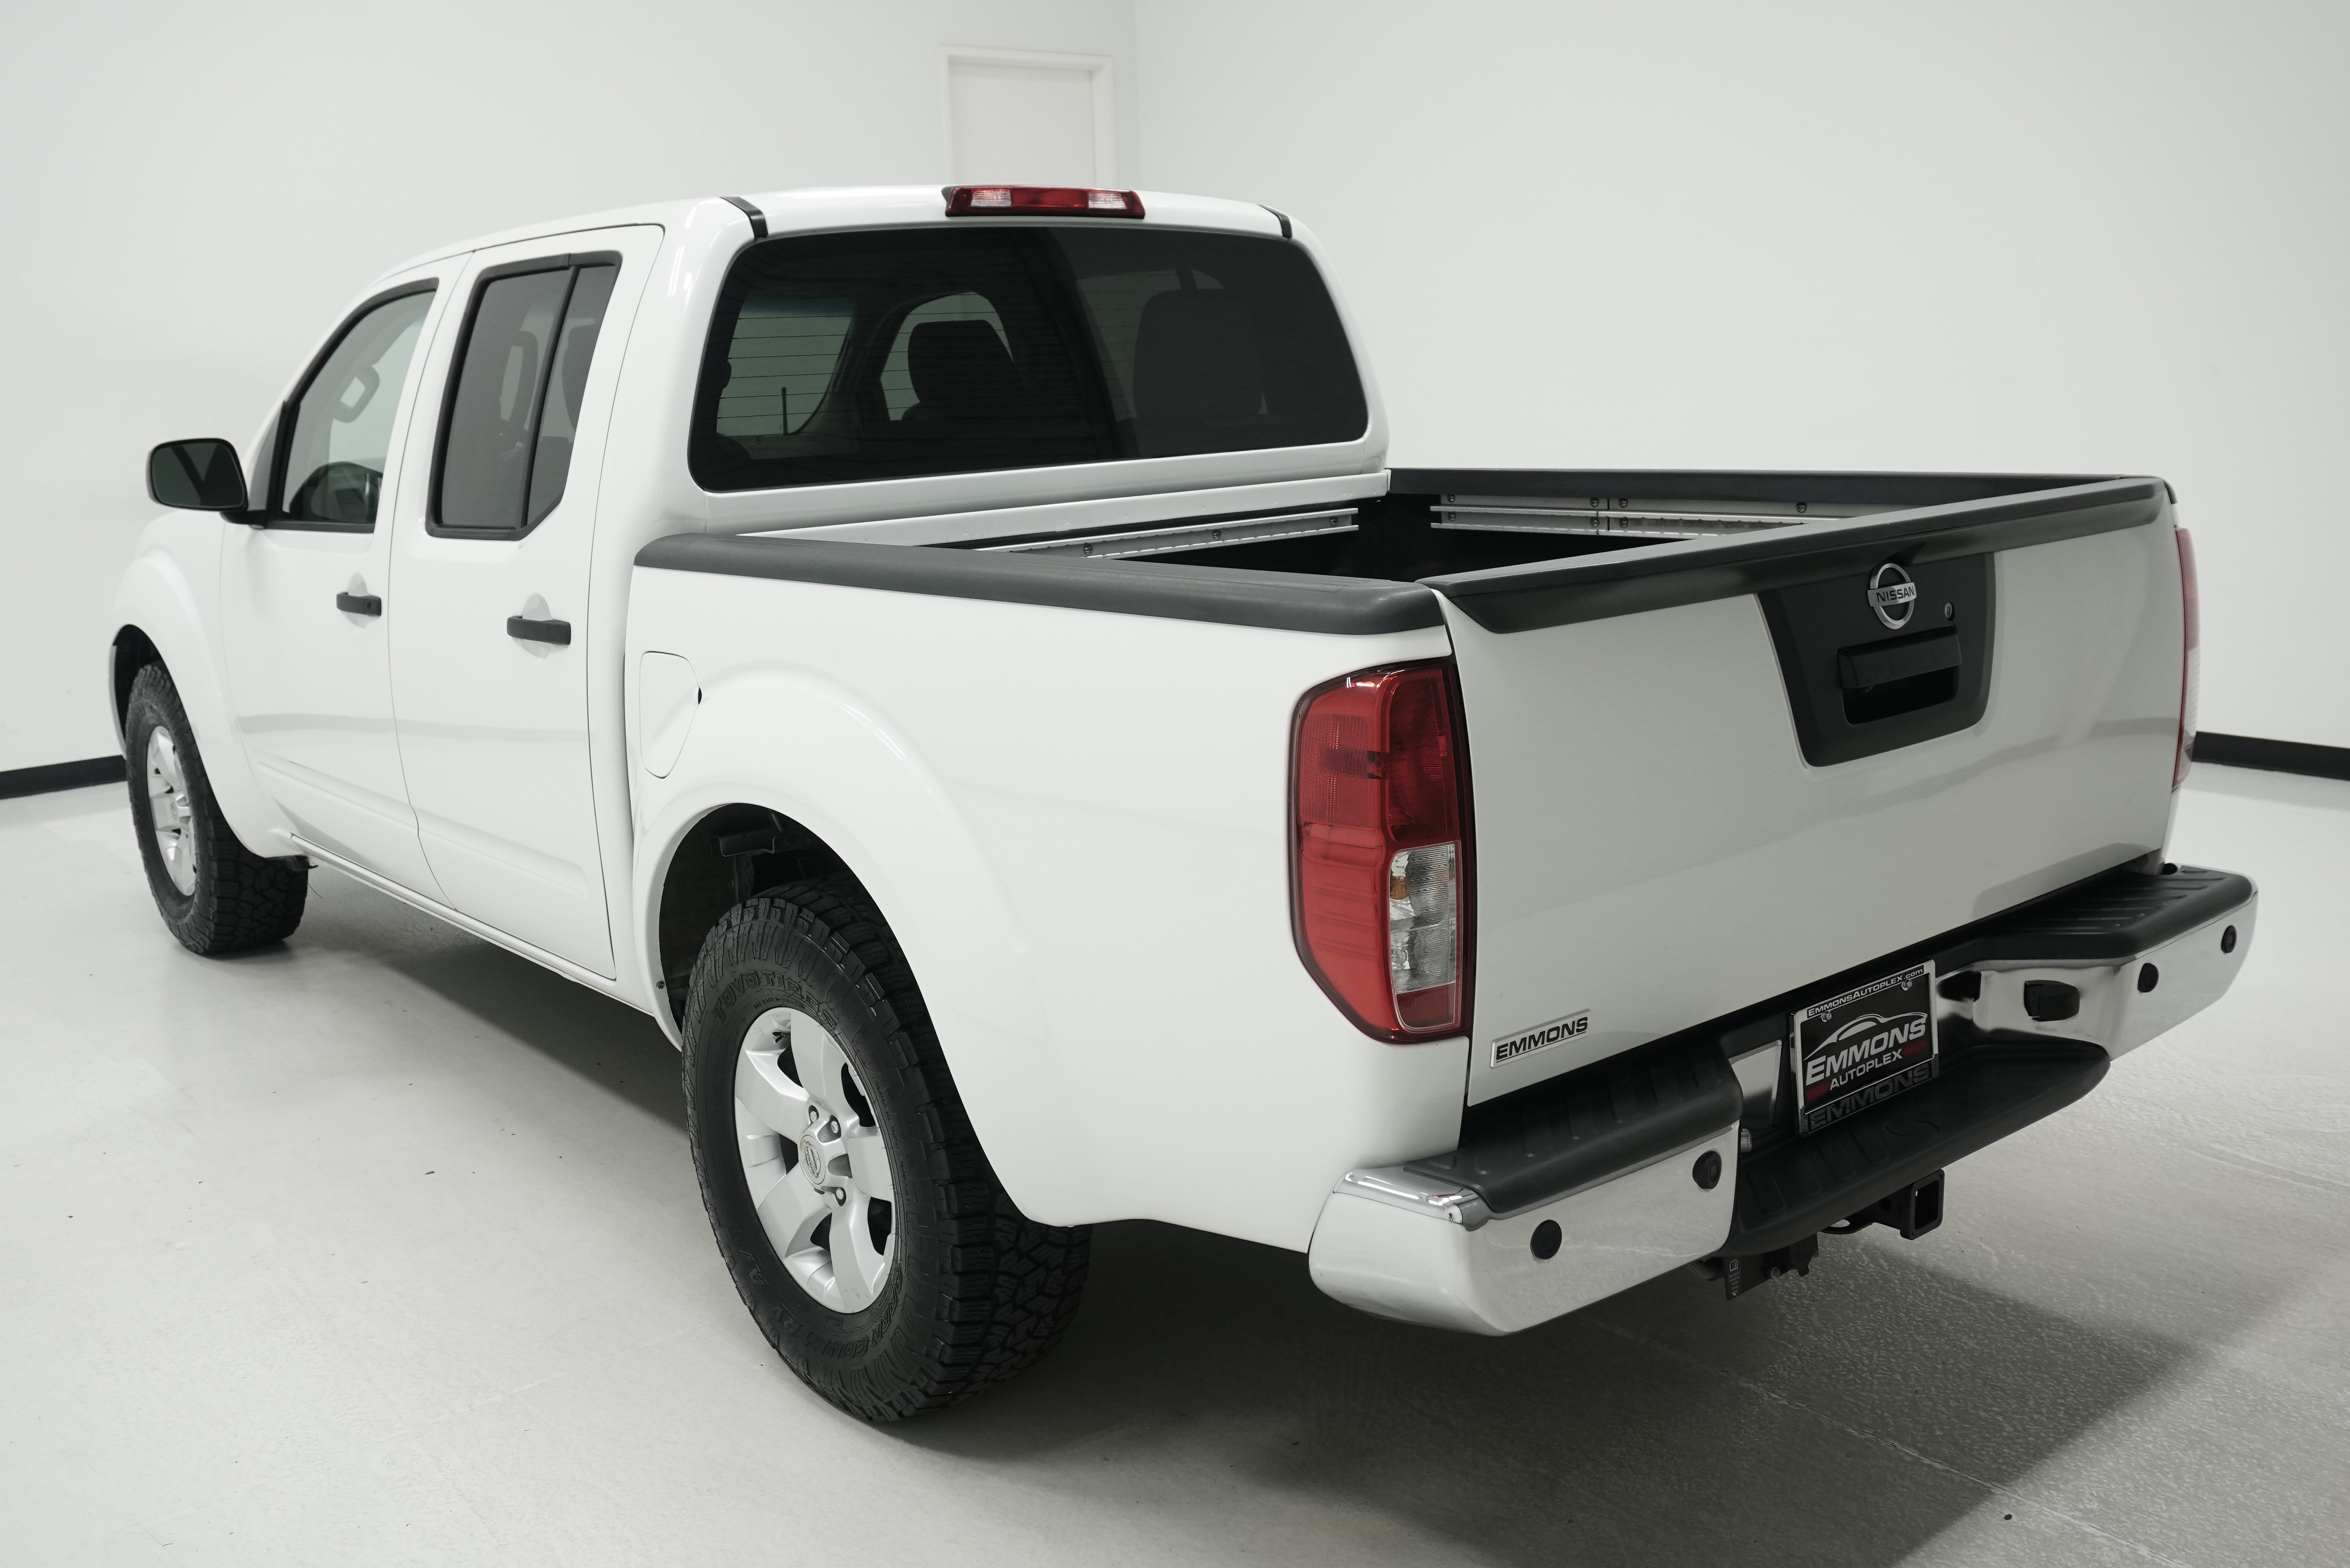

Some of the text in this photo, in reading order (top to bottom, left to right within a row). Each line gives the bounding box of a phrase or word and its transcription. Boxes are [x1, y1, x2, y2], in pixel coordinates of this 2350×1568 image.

[1876, 585, 1915, 603] NISSAN
[1496, 1016, 1588, 1060] EMMONS
[1806, 1019, 1927, 1086] EMMONS
[1829, 1048, 1903, 1091] AUTOPLEX
[1810, 1063, 1930, 1131] EMMONS
[806, 1146, 815, 1174] NISSAN
